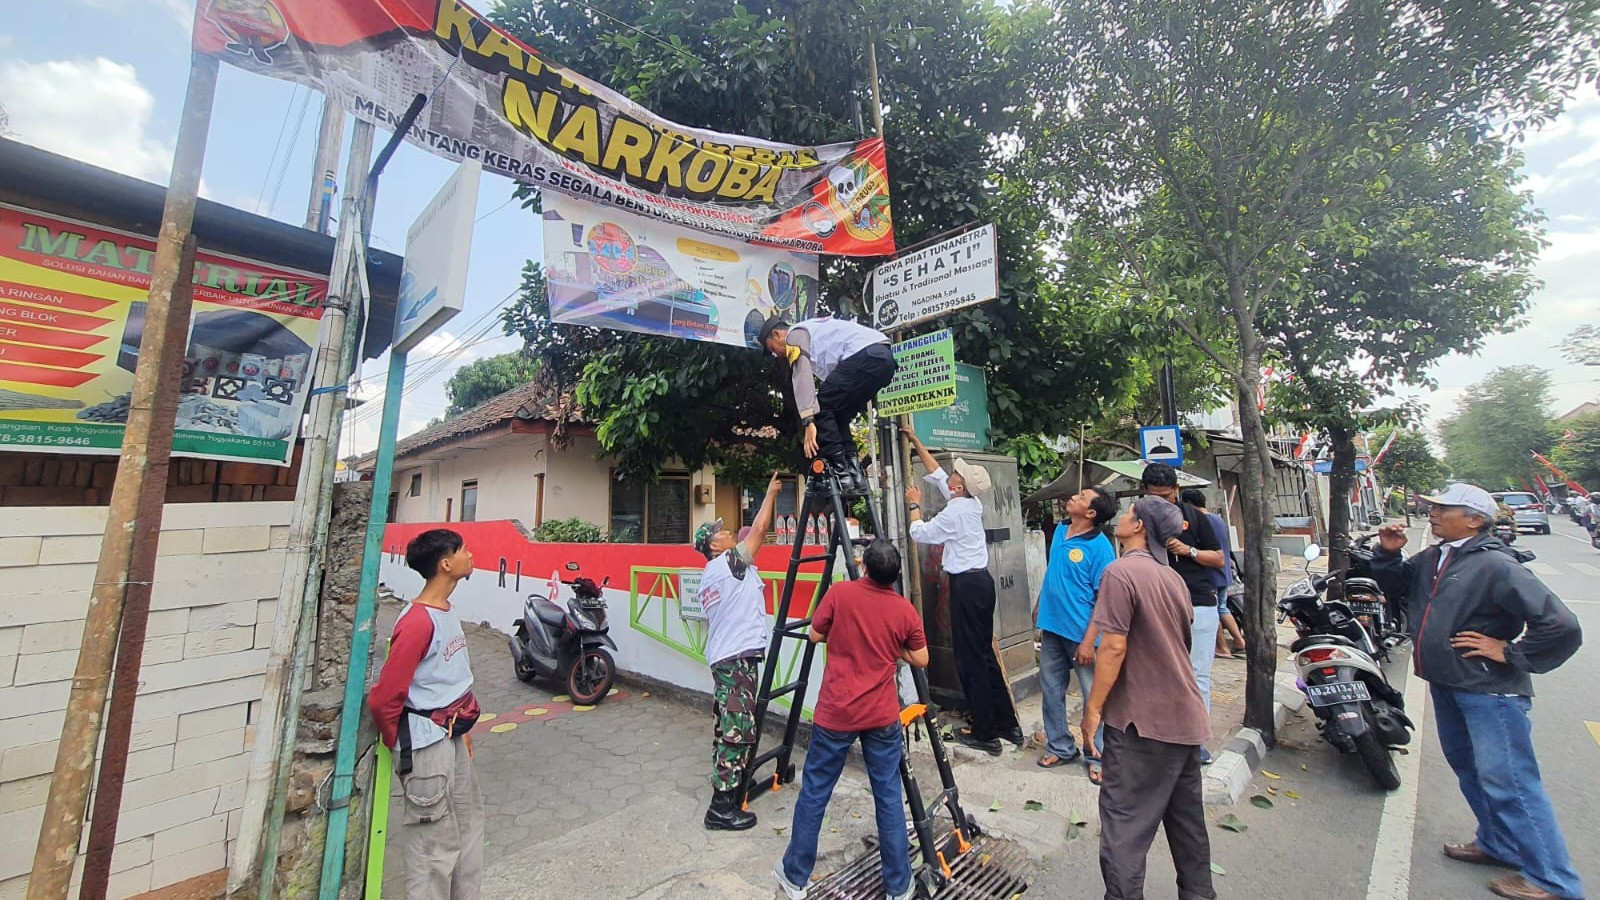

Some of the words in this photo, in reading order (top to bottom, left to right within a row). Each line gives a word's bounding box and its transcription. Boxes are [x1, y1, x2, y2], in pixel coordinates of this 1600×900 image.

[501, 76, 785, 204] NARKOBA
[483, 150, 546, 182] KERAS
[548, 171, 612, 203] SEGALA
[878, 260, 903, 276] GRIYA
[929, 227, 988, 256] TUNANETRA
[42, 259, 85, 273] SOLUSI
[87, 267, 126, 281] BAHAN
[901, 285, 908, 294] &
[953, 257, 993, 276] Massage
[8, 288, 63, 304] RINGAN
[20, 310, 58, 323] BLOK
[903, 331, 948, 351] PANGGILAN
[911, 348, 935, 361] RUANG
[923, 363, 951, 376] HEATER
[920, 374, 950, 384] LISTRIK
[0, 433, 91, 446] 8-3815-9646
